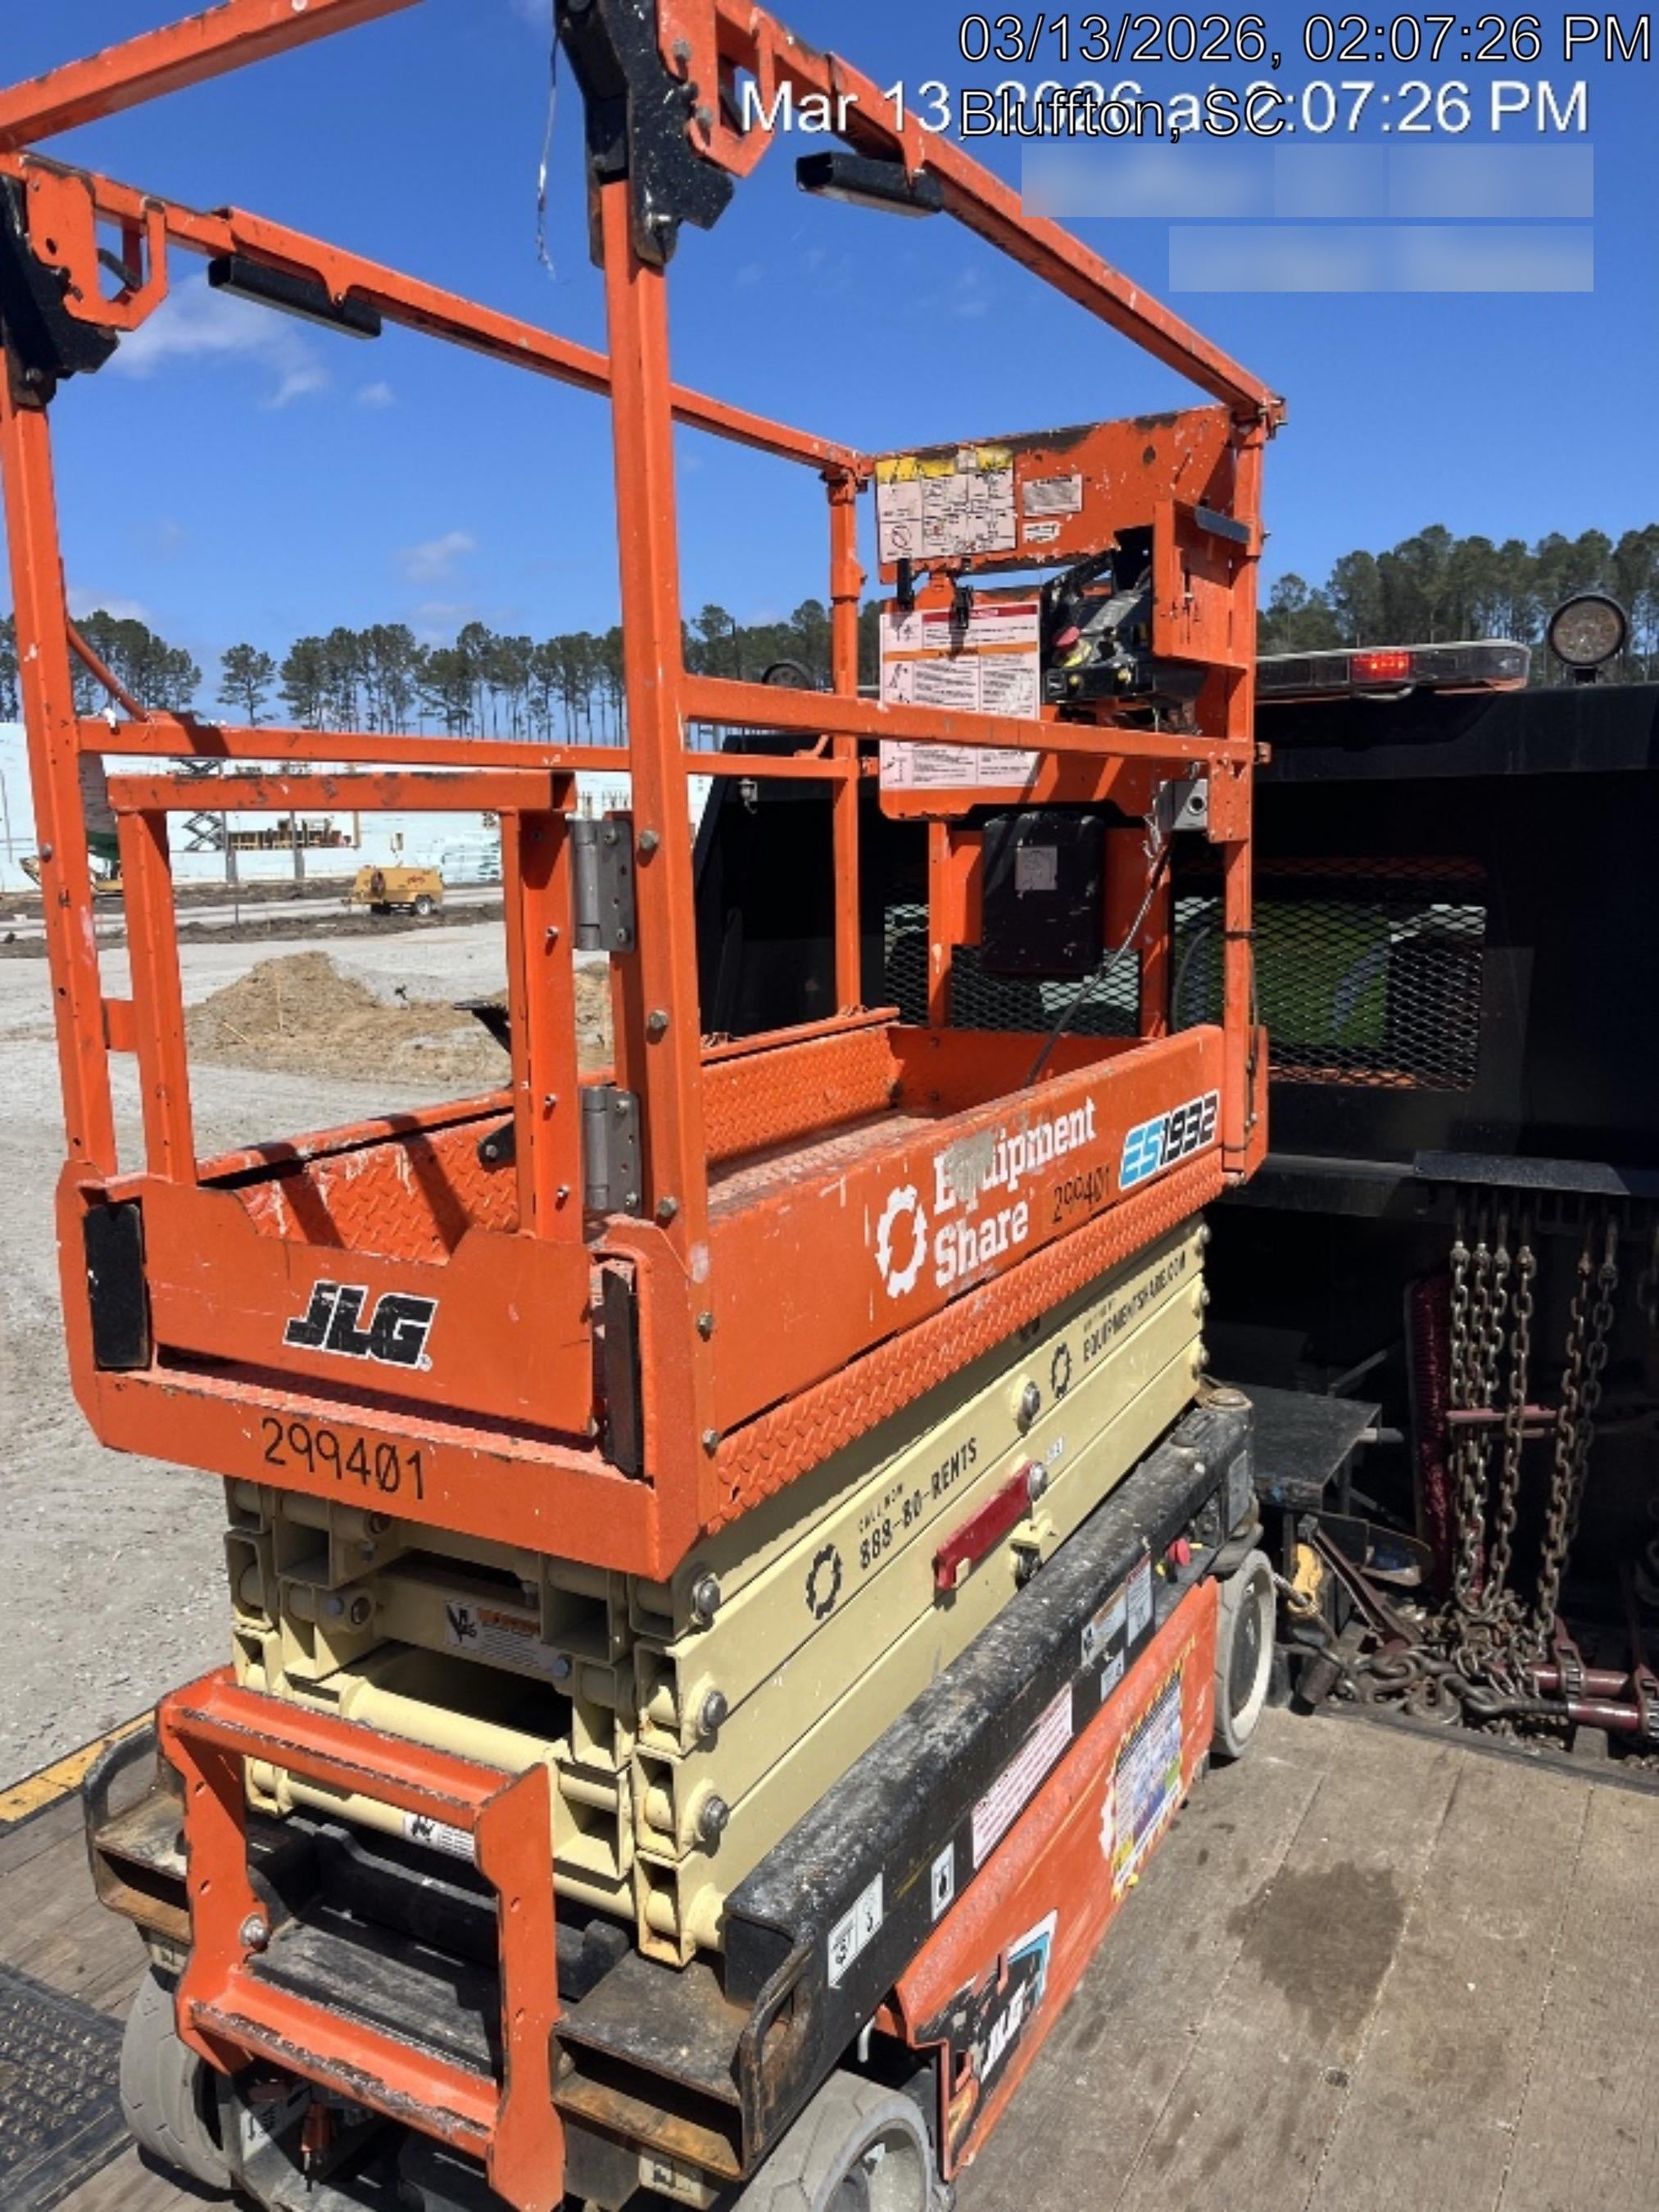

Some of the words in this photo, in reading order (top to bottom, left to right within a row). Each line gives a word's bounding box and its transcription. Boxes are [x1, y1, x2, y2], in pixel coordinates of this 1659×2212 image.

[1117, 1088, 1220, 1193] ES1932
[934, 1200, 1029, 1289] Share
[283, 1279, 438, 1370] JLG
[261, 1416, 424, 1500] 299401
[859, 1436, 977, 1571] 888-80-RENTS
